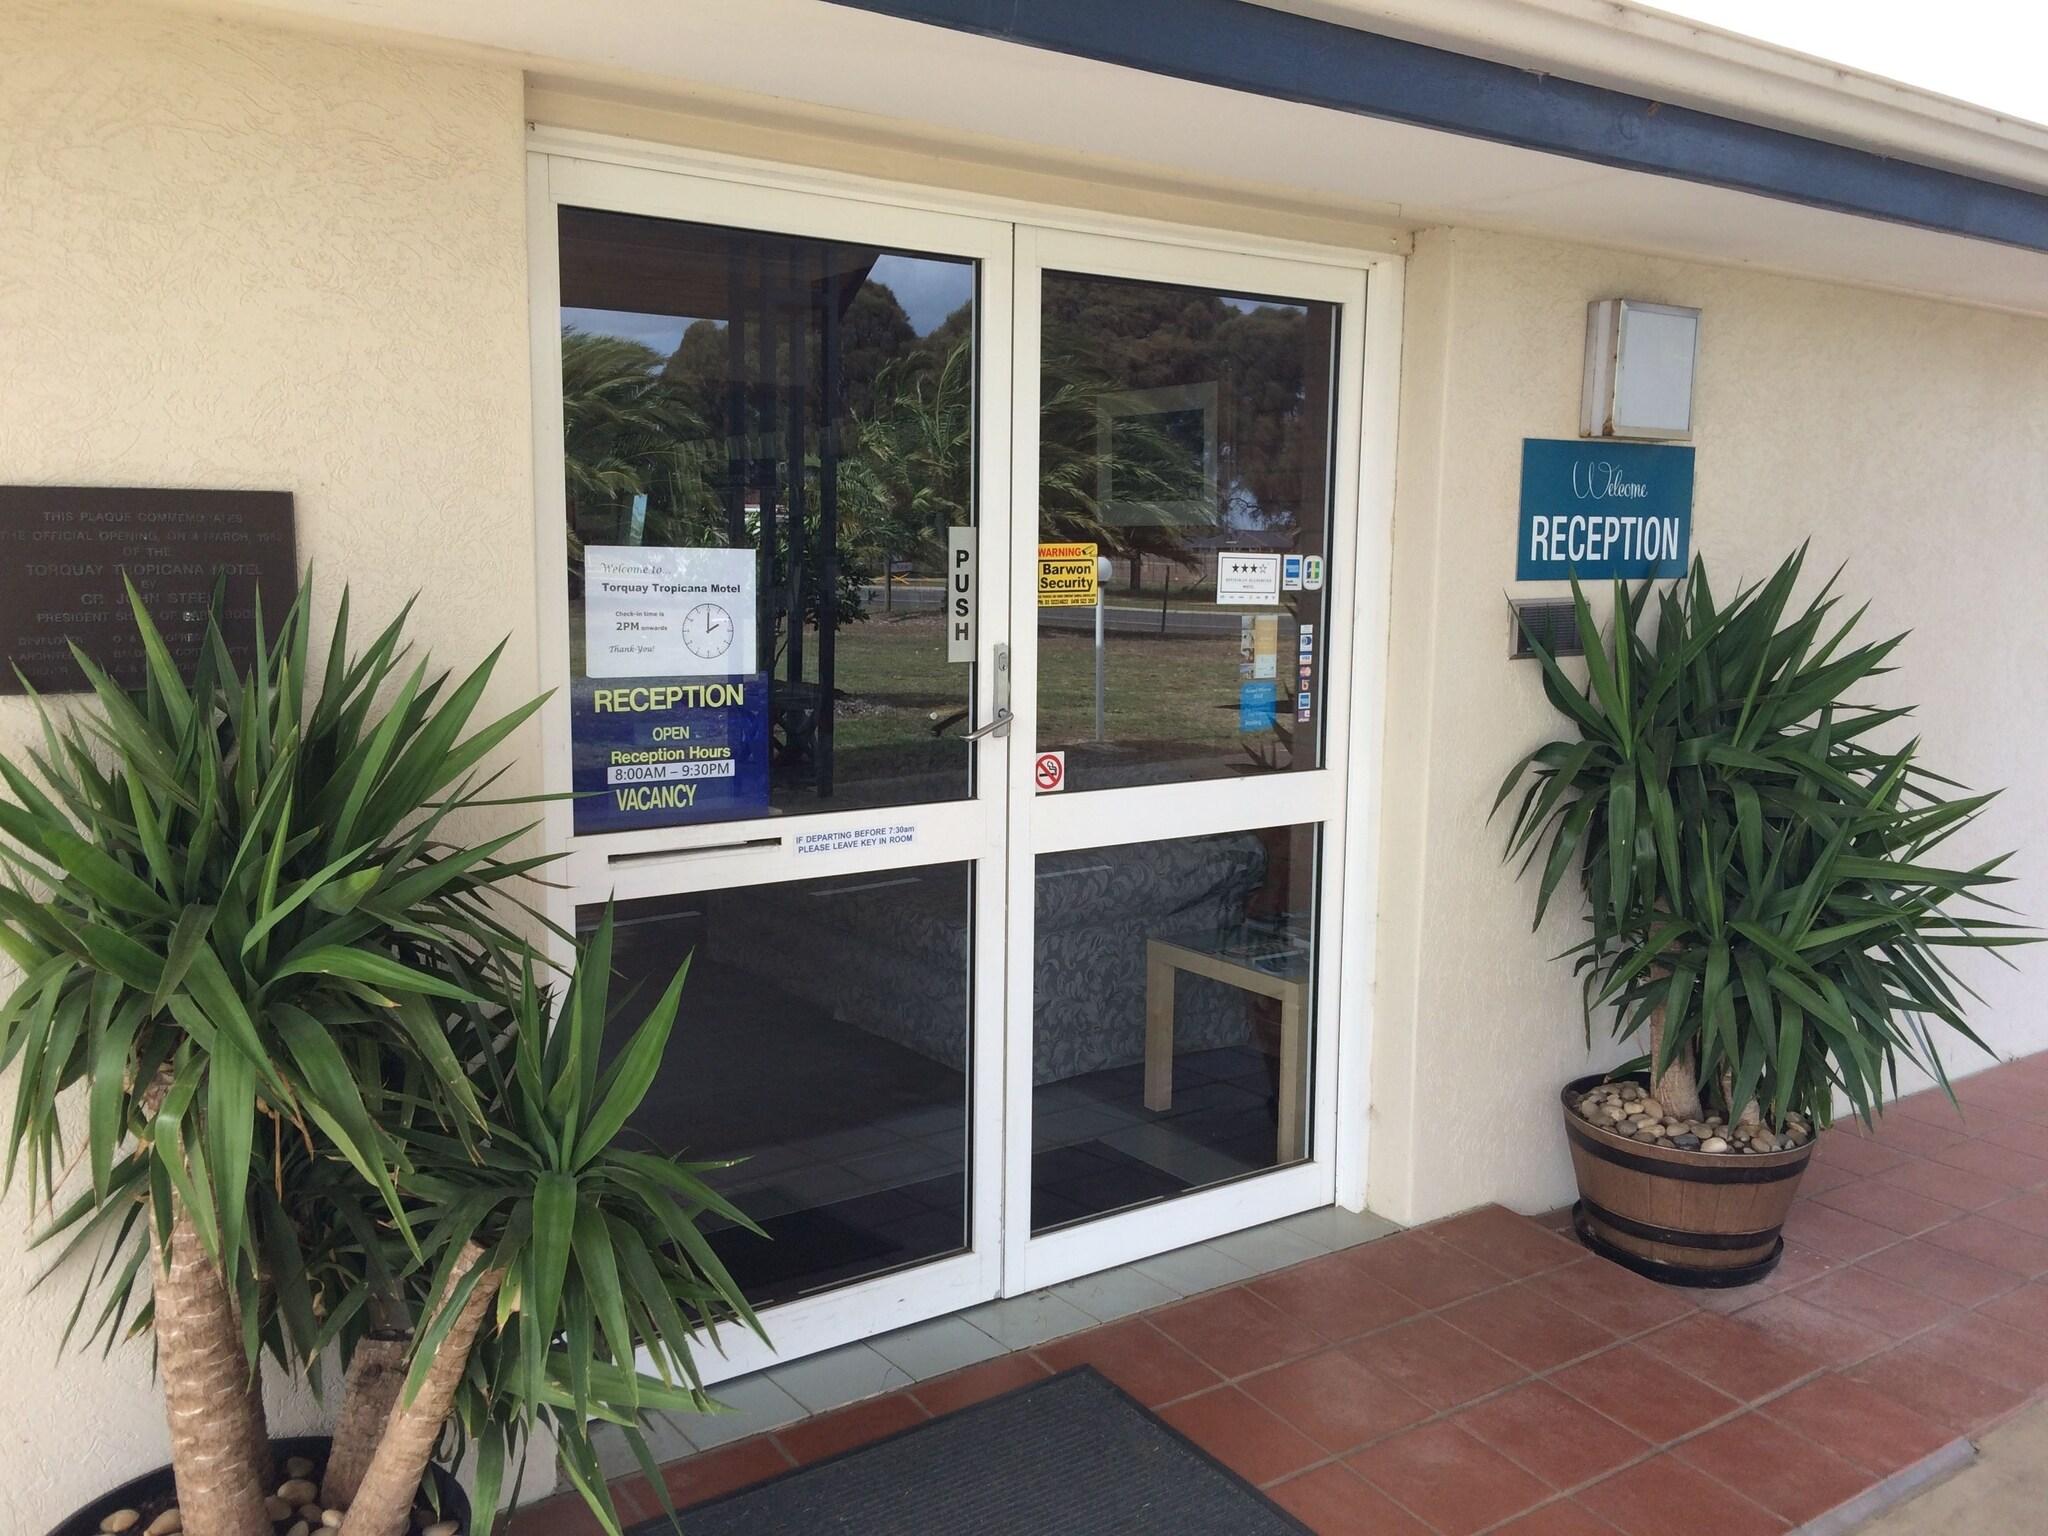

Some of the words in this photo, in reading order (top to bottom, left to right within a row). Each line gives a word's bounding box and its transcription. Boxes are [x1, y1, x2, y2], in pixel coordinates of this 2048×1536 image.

[1573, 460, 1649, 500] Welcome
[43, 511, 73, 521] THIS
[1531, 514, 1680, 562] RECEPTION
[601, 563, 649, 575] Welcome
[1043, 563, 1091, 575] Barwon
[602, 583, 649, 595] Torquay
[652, 583, 708, 595] Tropicana
[711, 584, 741, 593] Motel
[1040, 576, 1093, 590] Security
[955, 549, 970, 641] PUSH
[615, 610, 643, 618] Check-in
[616, 622, 640, 631] 2PM
[594, 683, 744, 713] RECEPTION
[652, 726, 690, 741] OPEN
[611, 748, 685, 765] Reception
[689, 746, 731, 760] Hours
[615, 766, 666, 781] 8:00AM
[681, 763, 730, 777] 9:30PM
[615, 784, 697, 812] VACANCY
[796, 836, 804, 844] IF
[806, 831, 852, 843] DEPARTING
[854, 827, 887, 838] BEFORE
[798, 843, 831, 854] PLEASE
[833, 841, 858, 850] LEAVE
[861, 838, 877, 847] KEY
[879, 837, 887, 845] IN
[889, 834, 913, 844] ROOM
